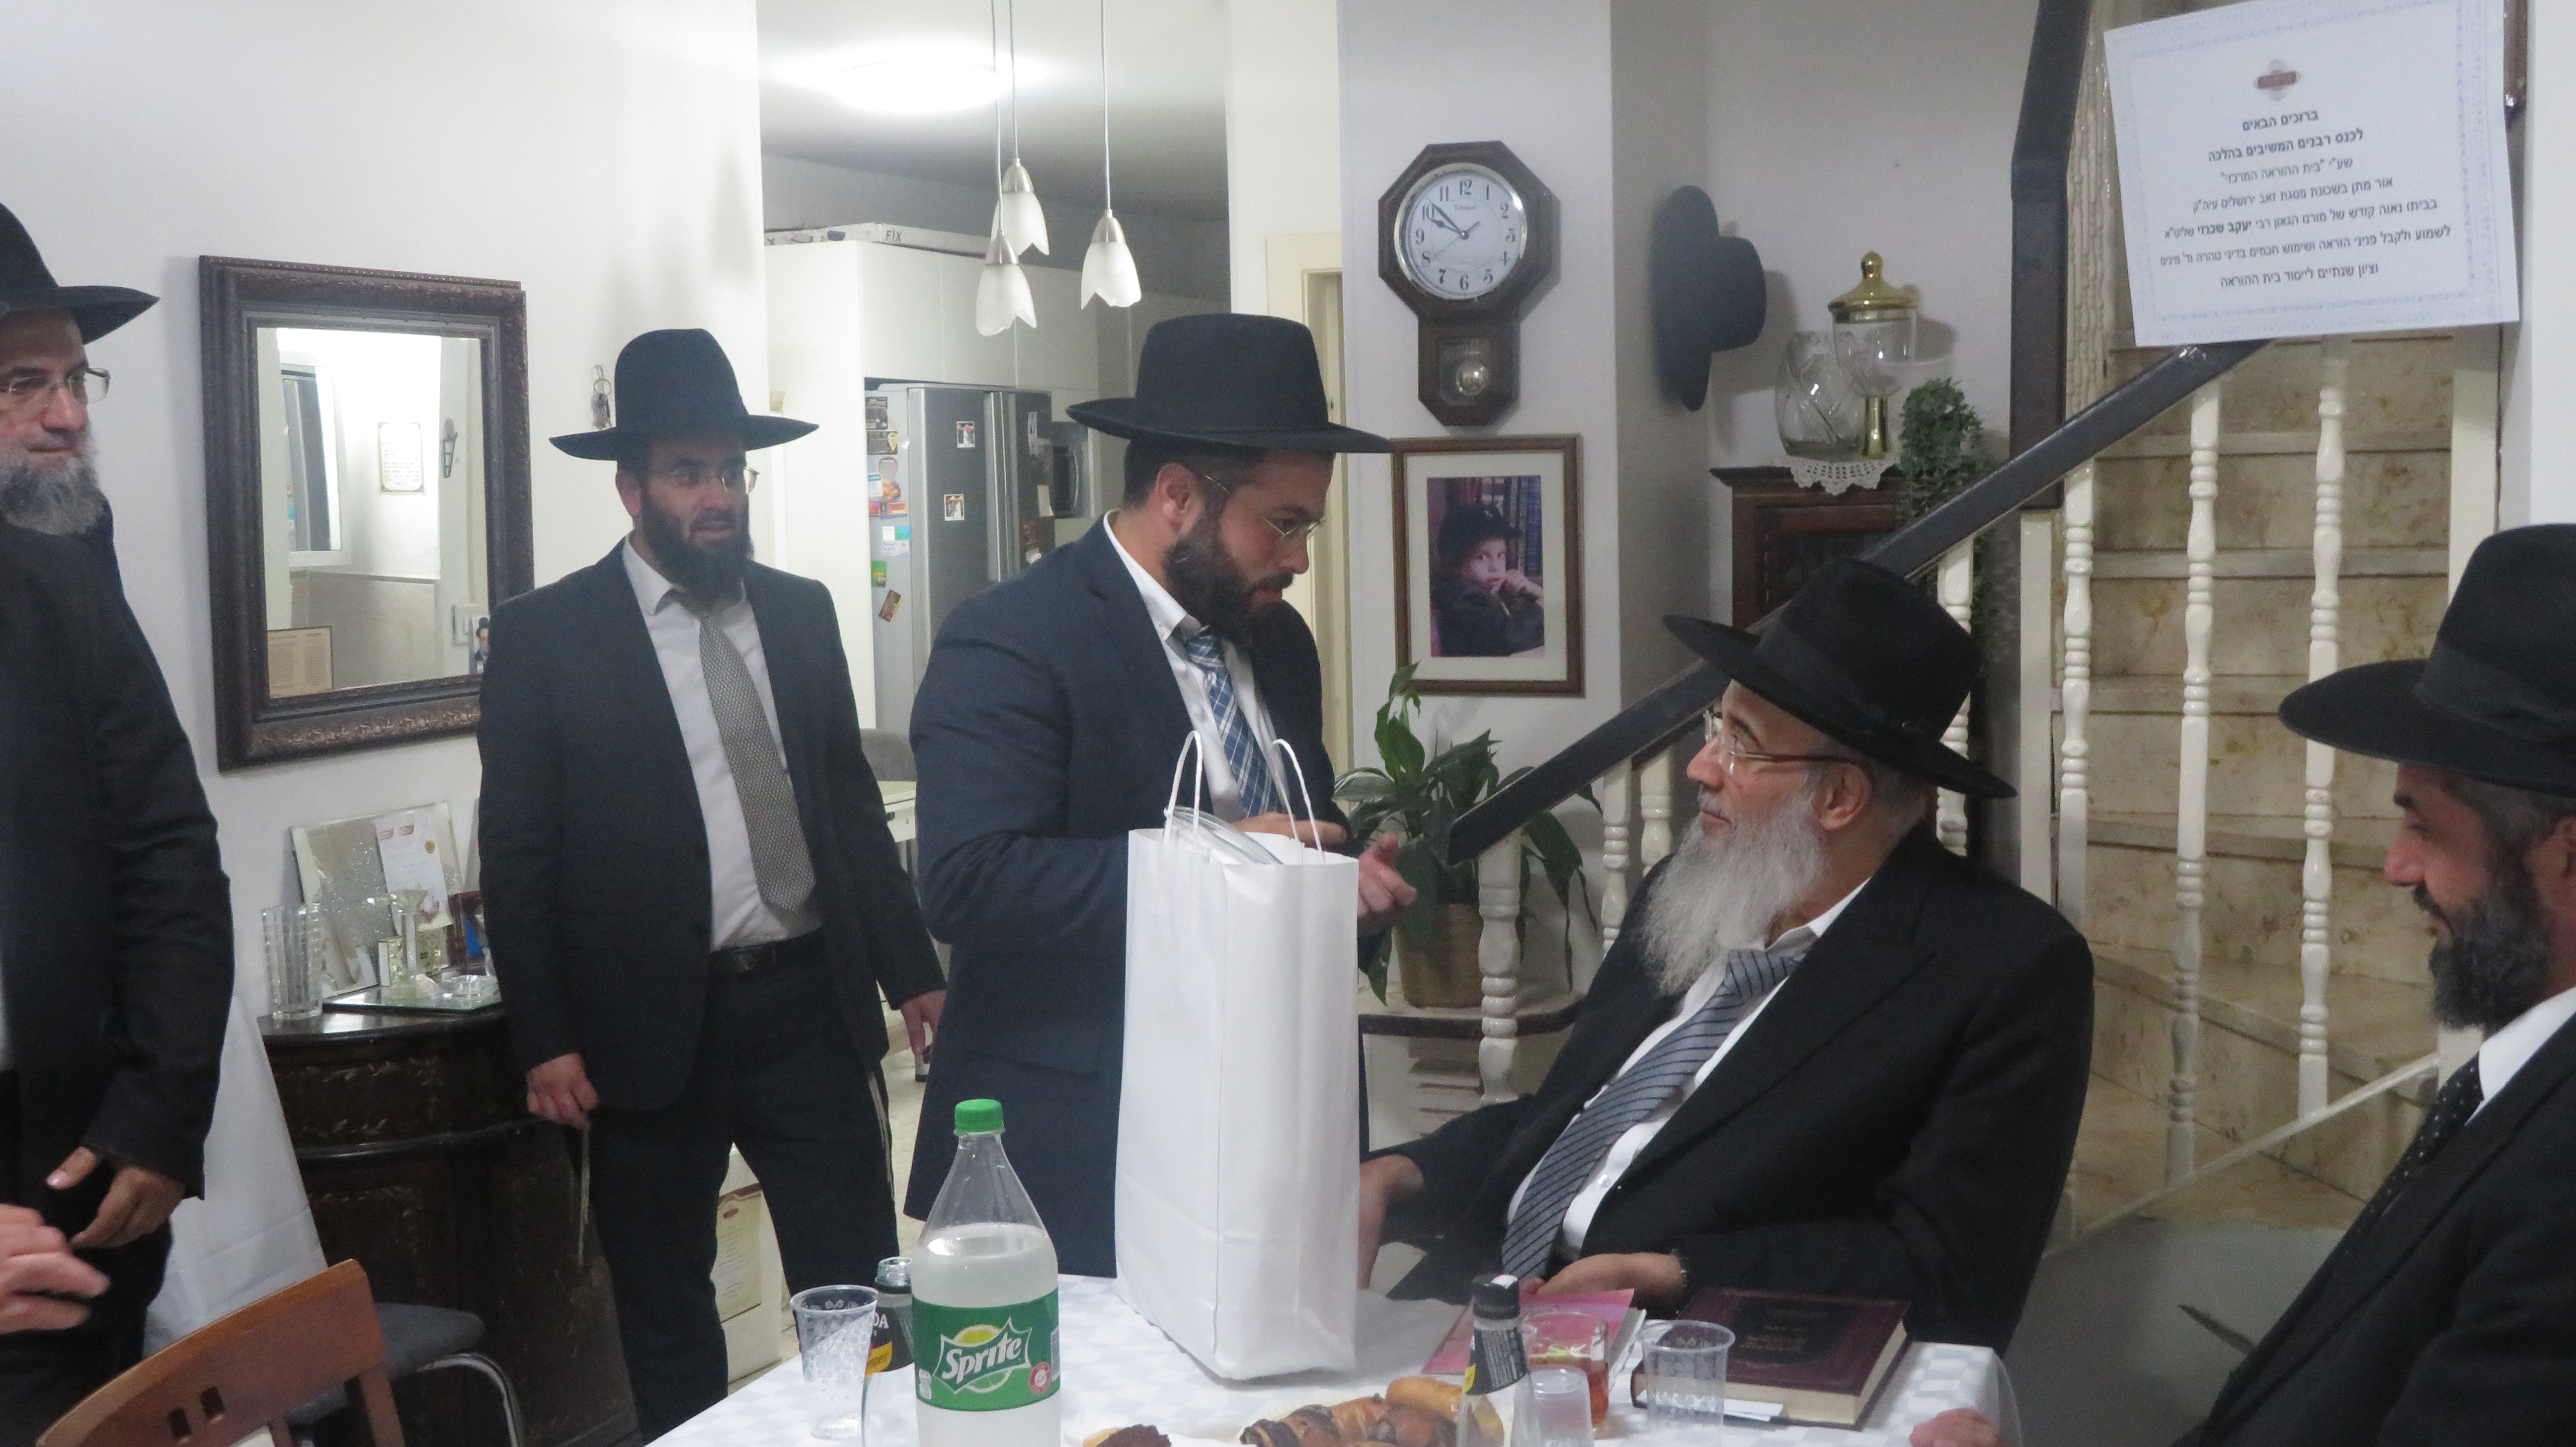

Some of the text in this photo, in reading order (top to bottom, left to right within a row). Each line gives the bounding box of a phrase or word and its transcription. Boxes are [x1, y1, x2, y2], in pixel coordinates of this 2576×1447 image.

[2242, 110, 2319, 131] ברוכים הבאים
[2208, 127, 2363, 162] לכנס רבנים המשיבים בהלכה
[2260, 165, 2299, 179] ההוראה
[1459, 178, 1472, 196] 12
[2351, 180, 2372, 195] מתן
[2374, 177, 2393, 188] אור
[1440, 186, 1449, 202] 11
[1486, 184, 1490, 200] 1
[2259, 192, 2276, 204] זאב
[2278, 188, 2307, 202] פסגת
[2310, 183, 2348, 198] בשכונת
[2220, 195, 2255, 209] ירושלים
[2379, 203, 2403, 215] נאוה
[2407, 198, 2438, 212] בביתו
[1422, 203, 1435, 220] 10
[1500, 203, 1509, 220] 2
[2302, 212, 2327, 225] מורנו
[2329, 208, 2345, 221] של
[2348, 206, 2375, 219] קודש
[2228, 220, 2252, 234] יעקב
[2255, 218, 2271, 229] רבי
[2273, 215, 2299, 229] הגאון
[886, 230, 902, 242] FIX
[1416, 228, 1425, 244] 9
[1506, 227, 1516, 242] 3
[2354, 234, 2377, 246] פניני
[2380, 228, 2411, 245] ולקבל
[2415, 224, 2450, 241] לשמוע
[2249, 244, 2279, 257] חכמים
[2281, 241, 2316, 254] ושימוש
[2319, 237, 2351, 250] הוראה
[1422, 251, 1431, 266] 8
[1500, 250, 1510, 266] 4
[2196, 250, 2221, 262] טהרה
[2224, 248, 2246, 260] בדיני
[1439, 268, 1447, 284] 7
[1459, 275, 1469, 290] 6
[1483, 268, 1494, 284] 5
[2220, 263, 2379, 287] וציון שנתיים לייסוד בית ההוראה
[873, 1312, 889, 1329] DA
[941, 1331, 1022, 1384] Sprite
